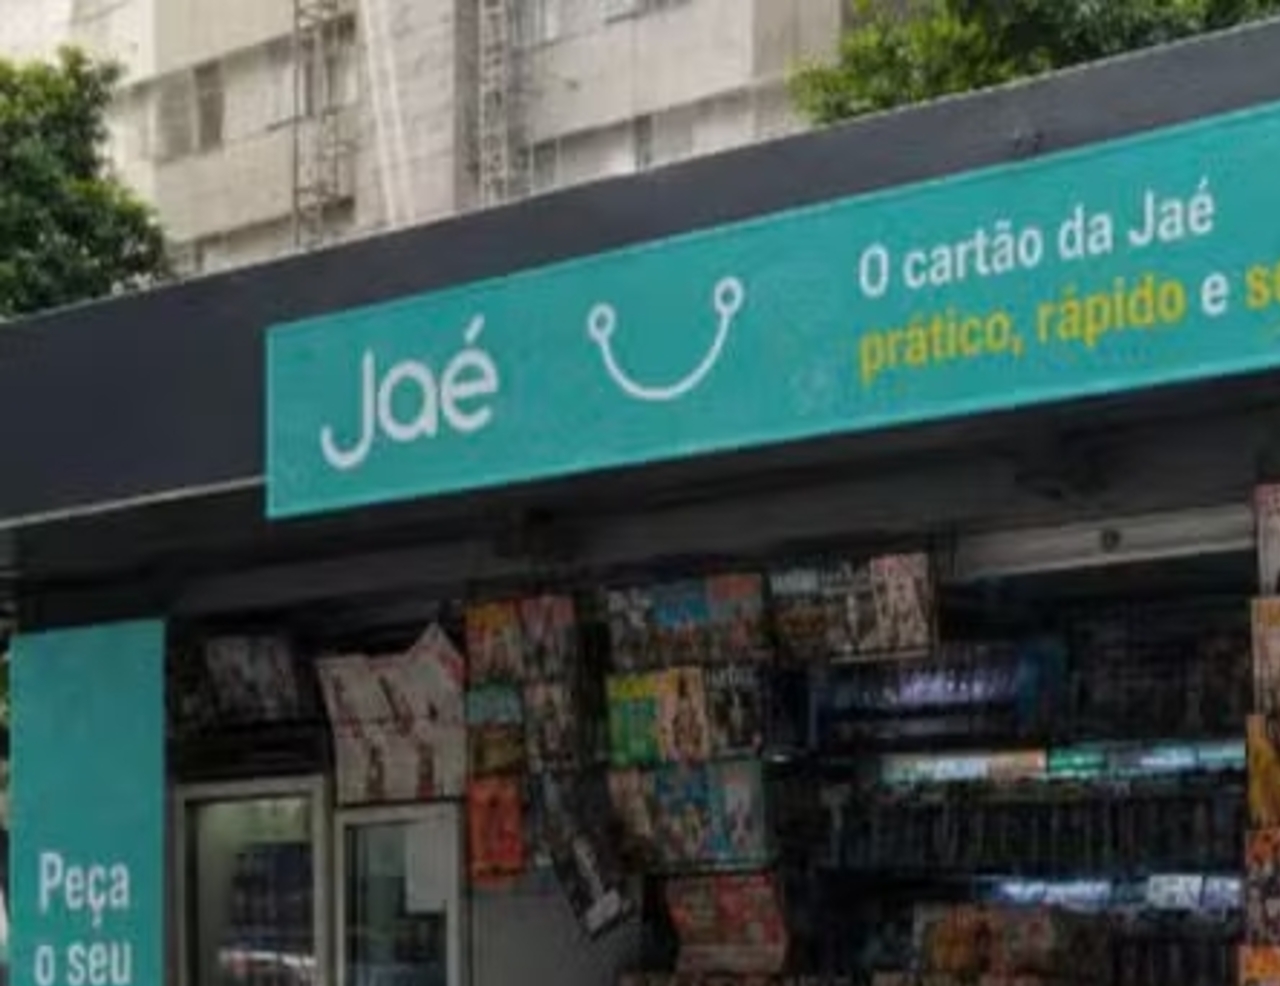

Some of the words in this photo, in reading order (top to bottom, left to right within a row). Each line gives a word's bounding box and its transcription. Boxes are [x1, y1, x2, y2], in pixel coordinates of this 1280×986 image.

[859, 244, 889, 297] O
[903, 220, 1043, 288] cartão
[1058, 204, 1113, 260] da
[1129, 177, 1215, 246] Jaé
[859, 306, 1025, 384] prático,
[1037, 271, 1187, 347] rápido
[1201, 271, 1229, 316] e
[320, 314, 499, 470] Jaé
[39, 852, 130, 928] Peça
